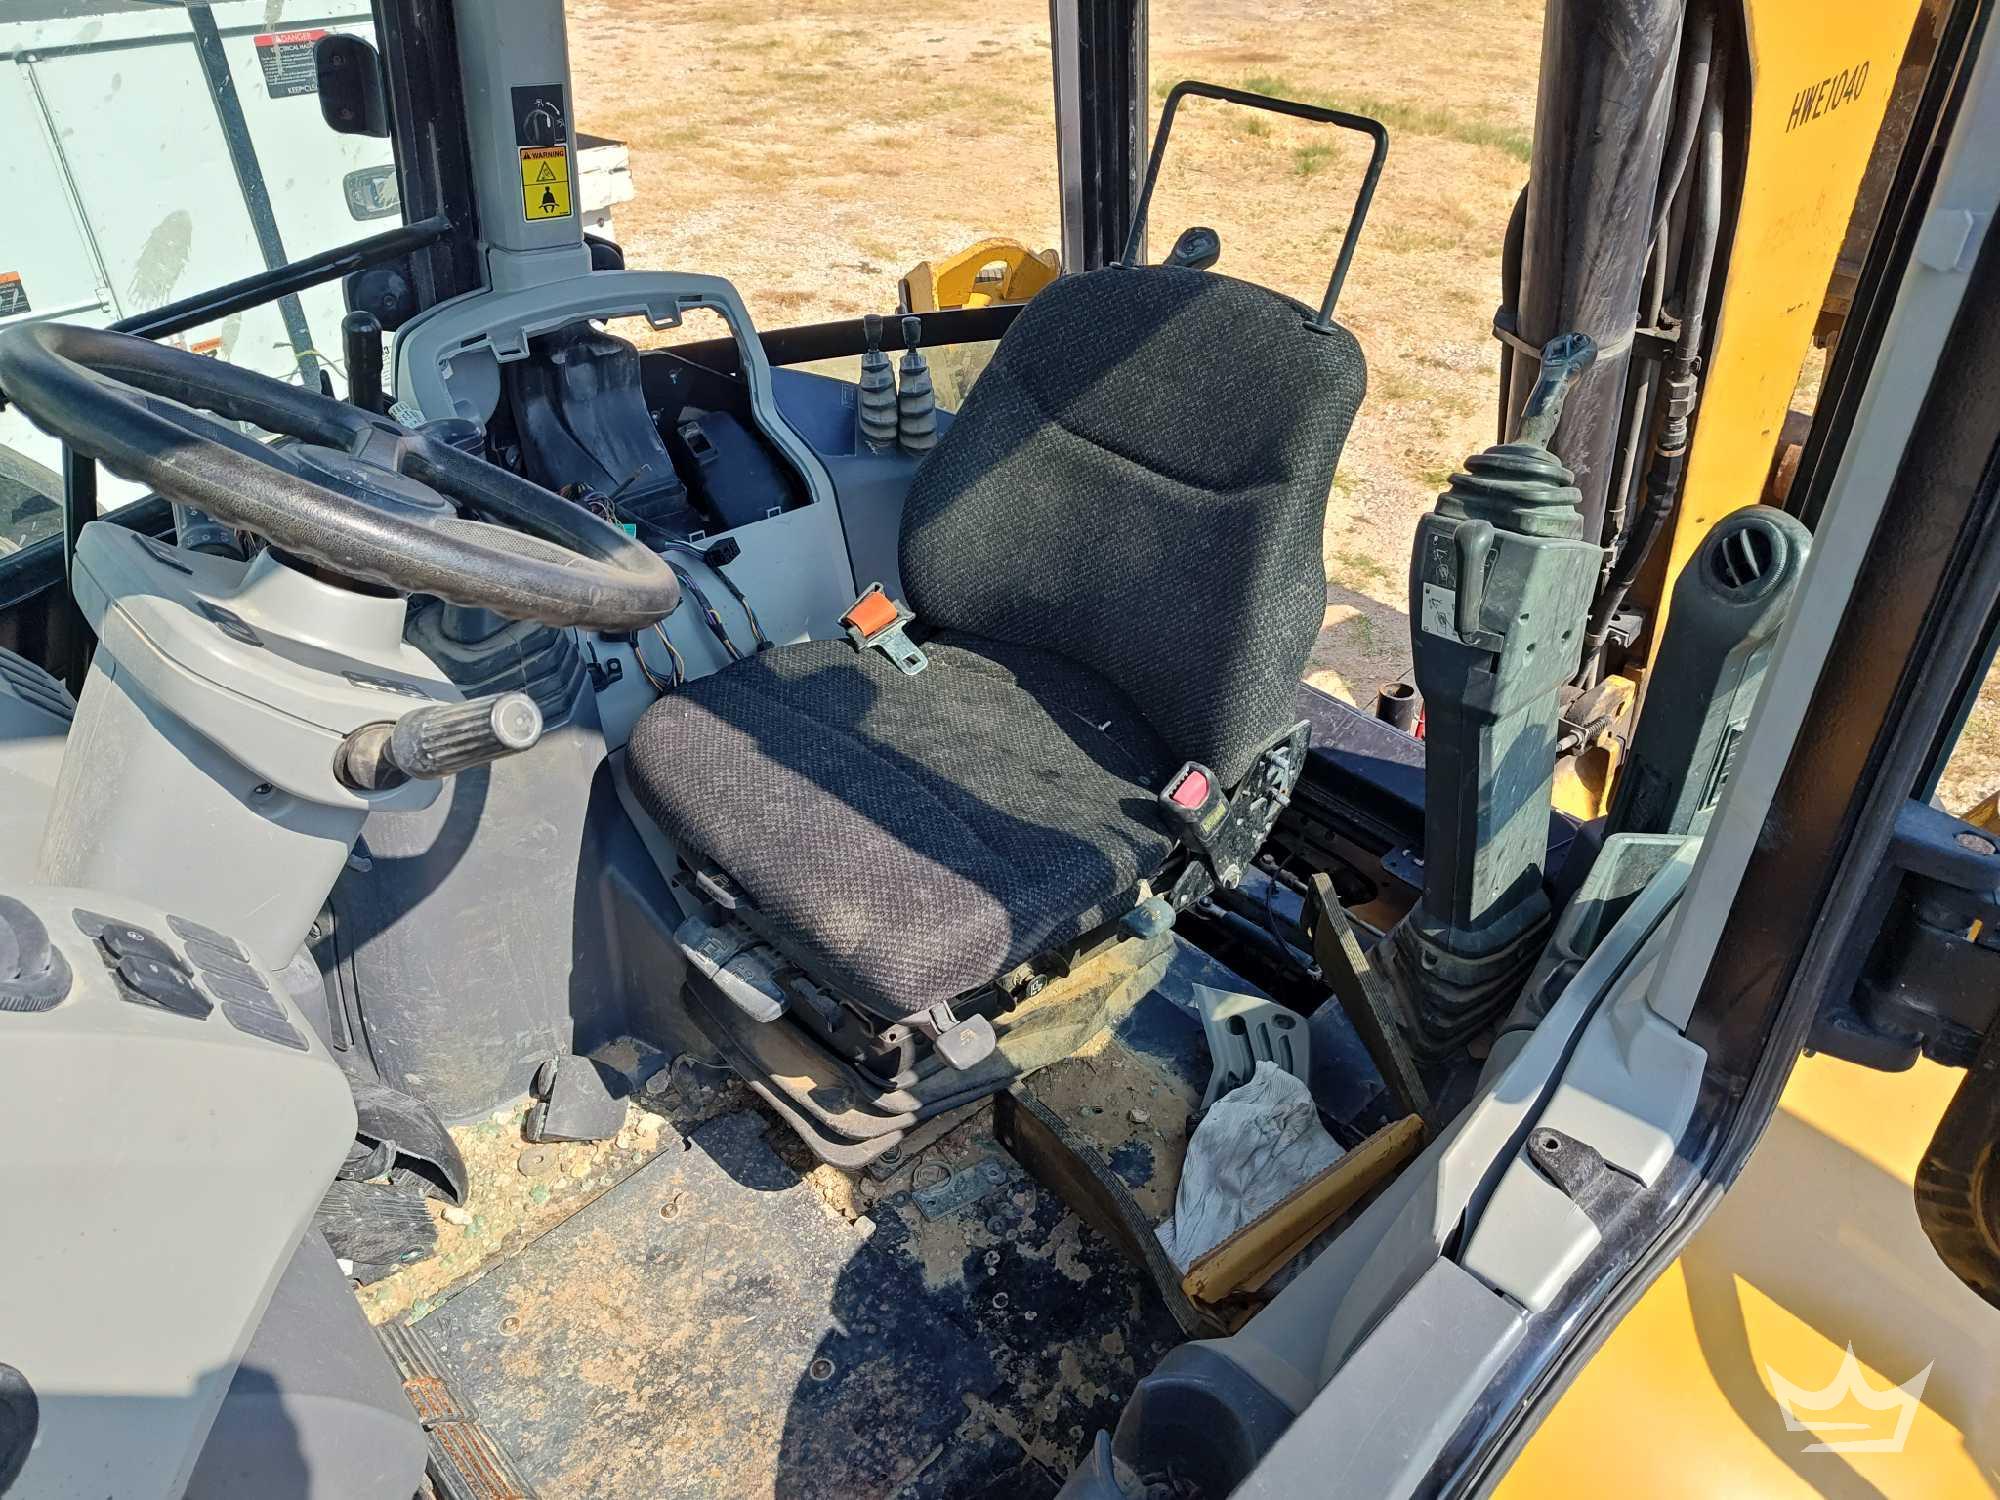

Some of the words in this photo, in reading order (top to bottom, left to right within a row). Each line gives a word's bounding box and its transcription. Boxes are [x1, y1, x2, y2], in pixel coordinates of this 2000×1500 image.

[281, 31, 311, 42] DANGER
[1785, 60, 1870, 133] HWE1040
[532, 150, 564, 159] WARNING
